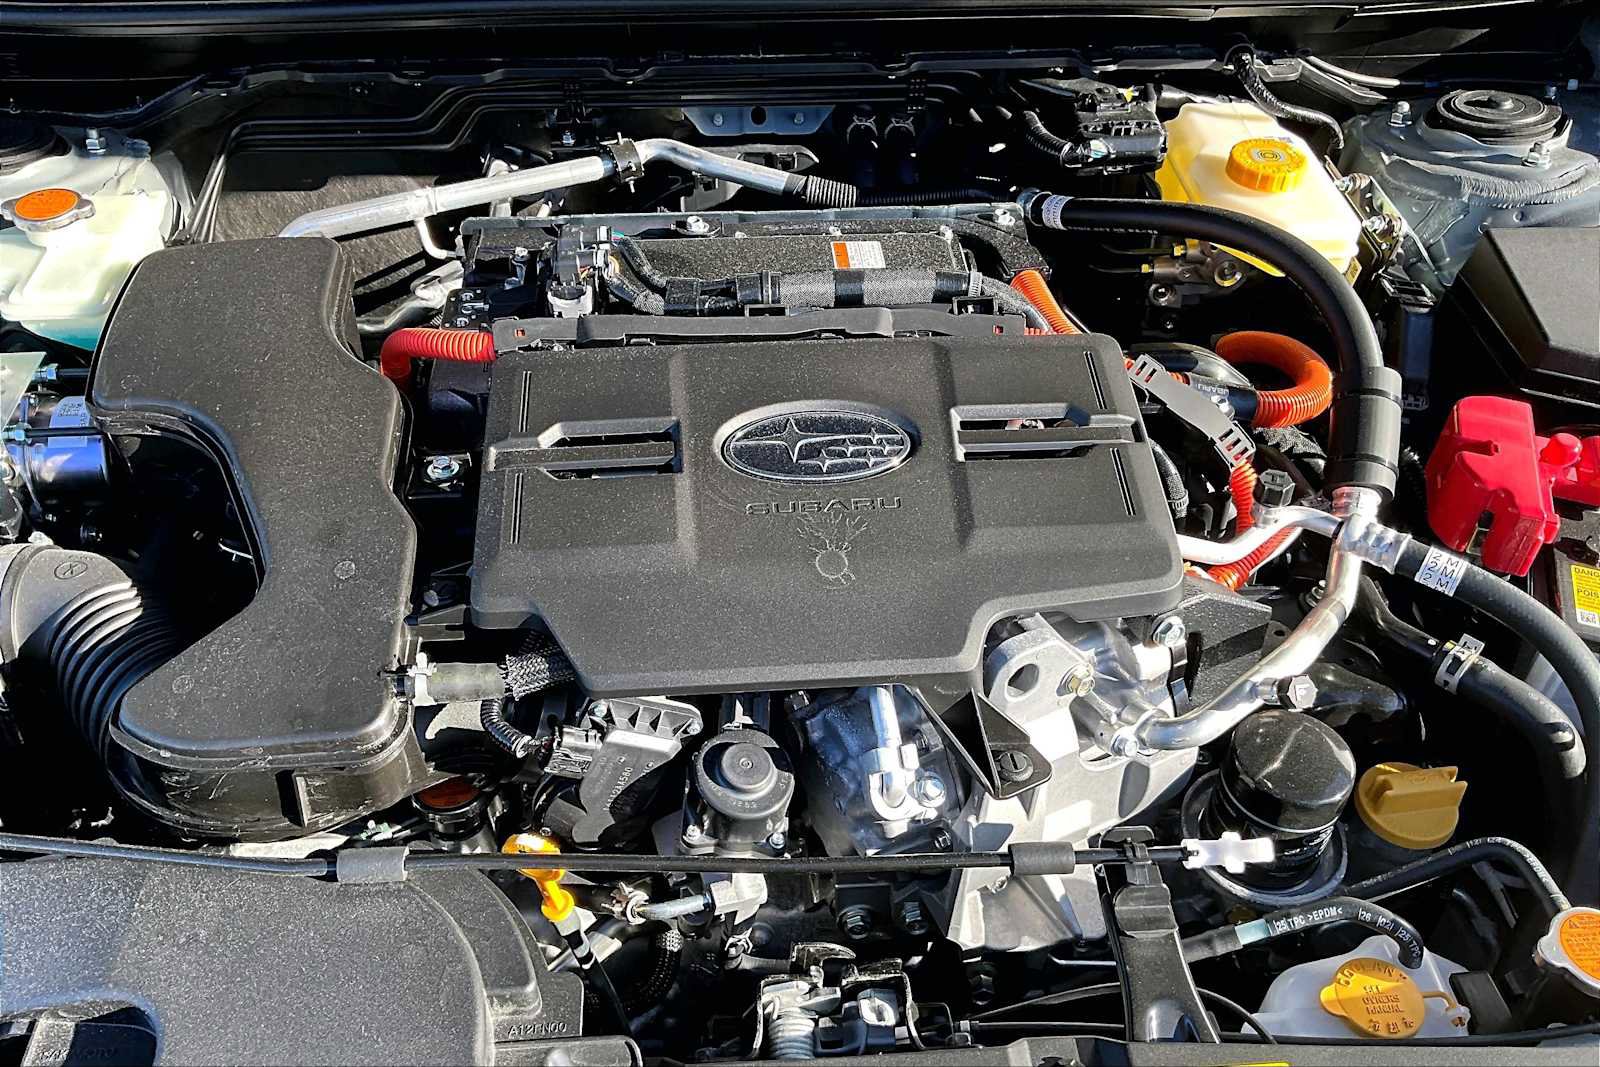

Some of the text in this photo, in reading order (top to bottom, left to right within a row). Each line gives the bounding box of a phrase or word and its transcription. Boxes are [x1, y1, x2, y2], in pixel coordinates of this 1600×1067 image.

[744, 496, 902, 515] SUBARU
[1427, 560, 1455, 580] 2 M
[1446, 557, 1460, 568] M
[1422, 572, 1449, 590] 2 M
